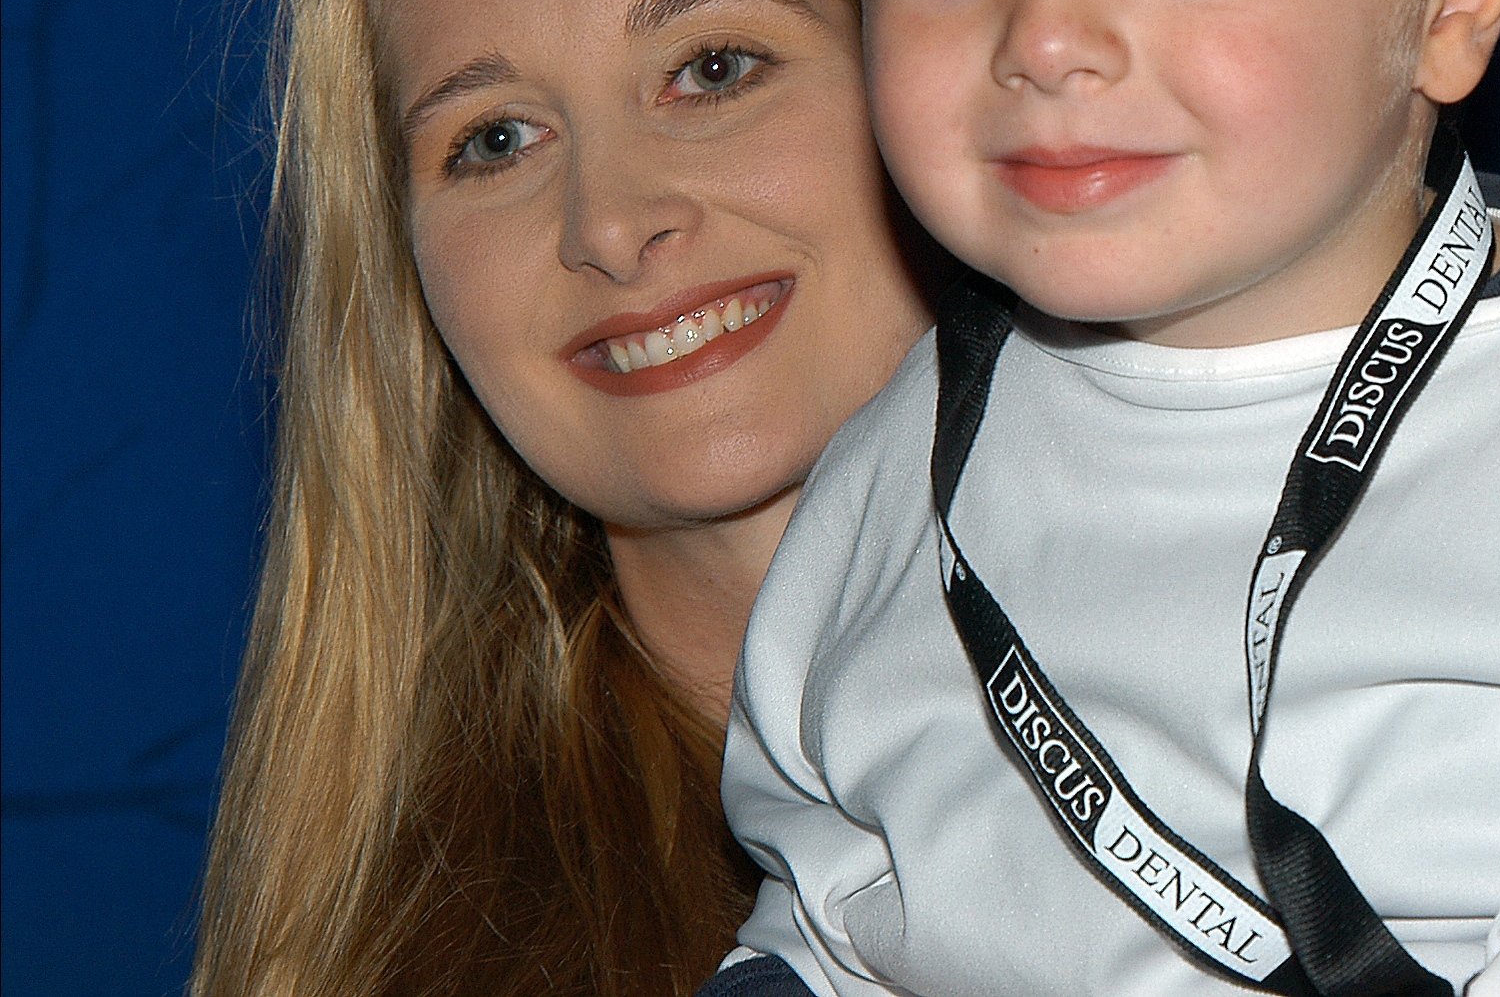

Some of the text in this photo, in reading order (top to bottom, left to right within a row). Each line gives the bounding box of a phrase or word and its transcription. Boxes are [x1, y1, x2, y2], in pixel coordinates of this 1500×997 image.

[1327, 322, 1425, 449] DISCUS
[999, 670, 1265, 966] DISCUS DENTAL
